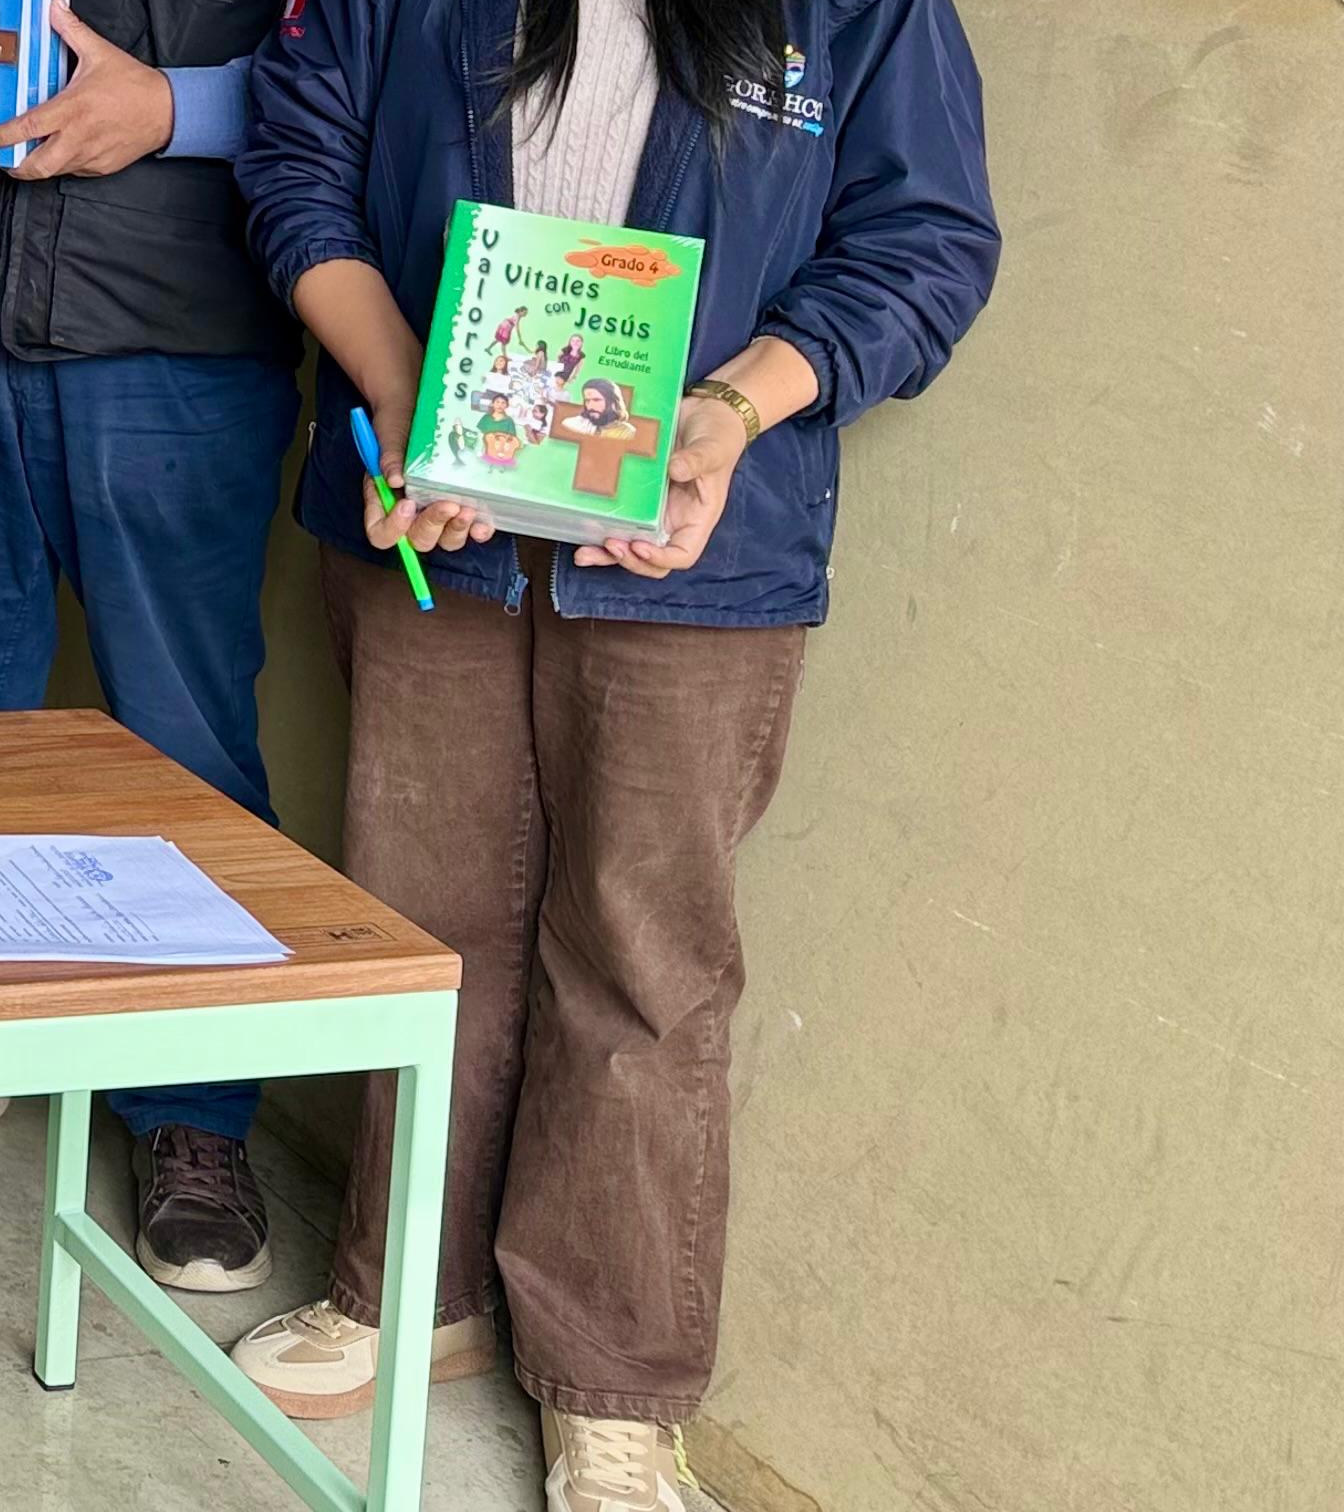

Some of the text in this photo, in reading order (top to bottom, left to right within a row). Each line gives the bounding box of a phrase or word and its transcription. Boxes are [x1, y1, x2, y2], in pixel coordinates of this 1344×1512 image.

[601, 254, 660, 275] Grado 4
[505, 263, 600, 300] Vitales
[544, 301, 570, 314] con
[574, 307, 651, 340] Jesús
[605, 345, 648, 362] Libro del
[598, 356, 652, 374] Estudiante
